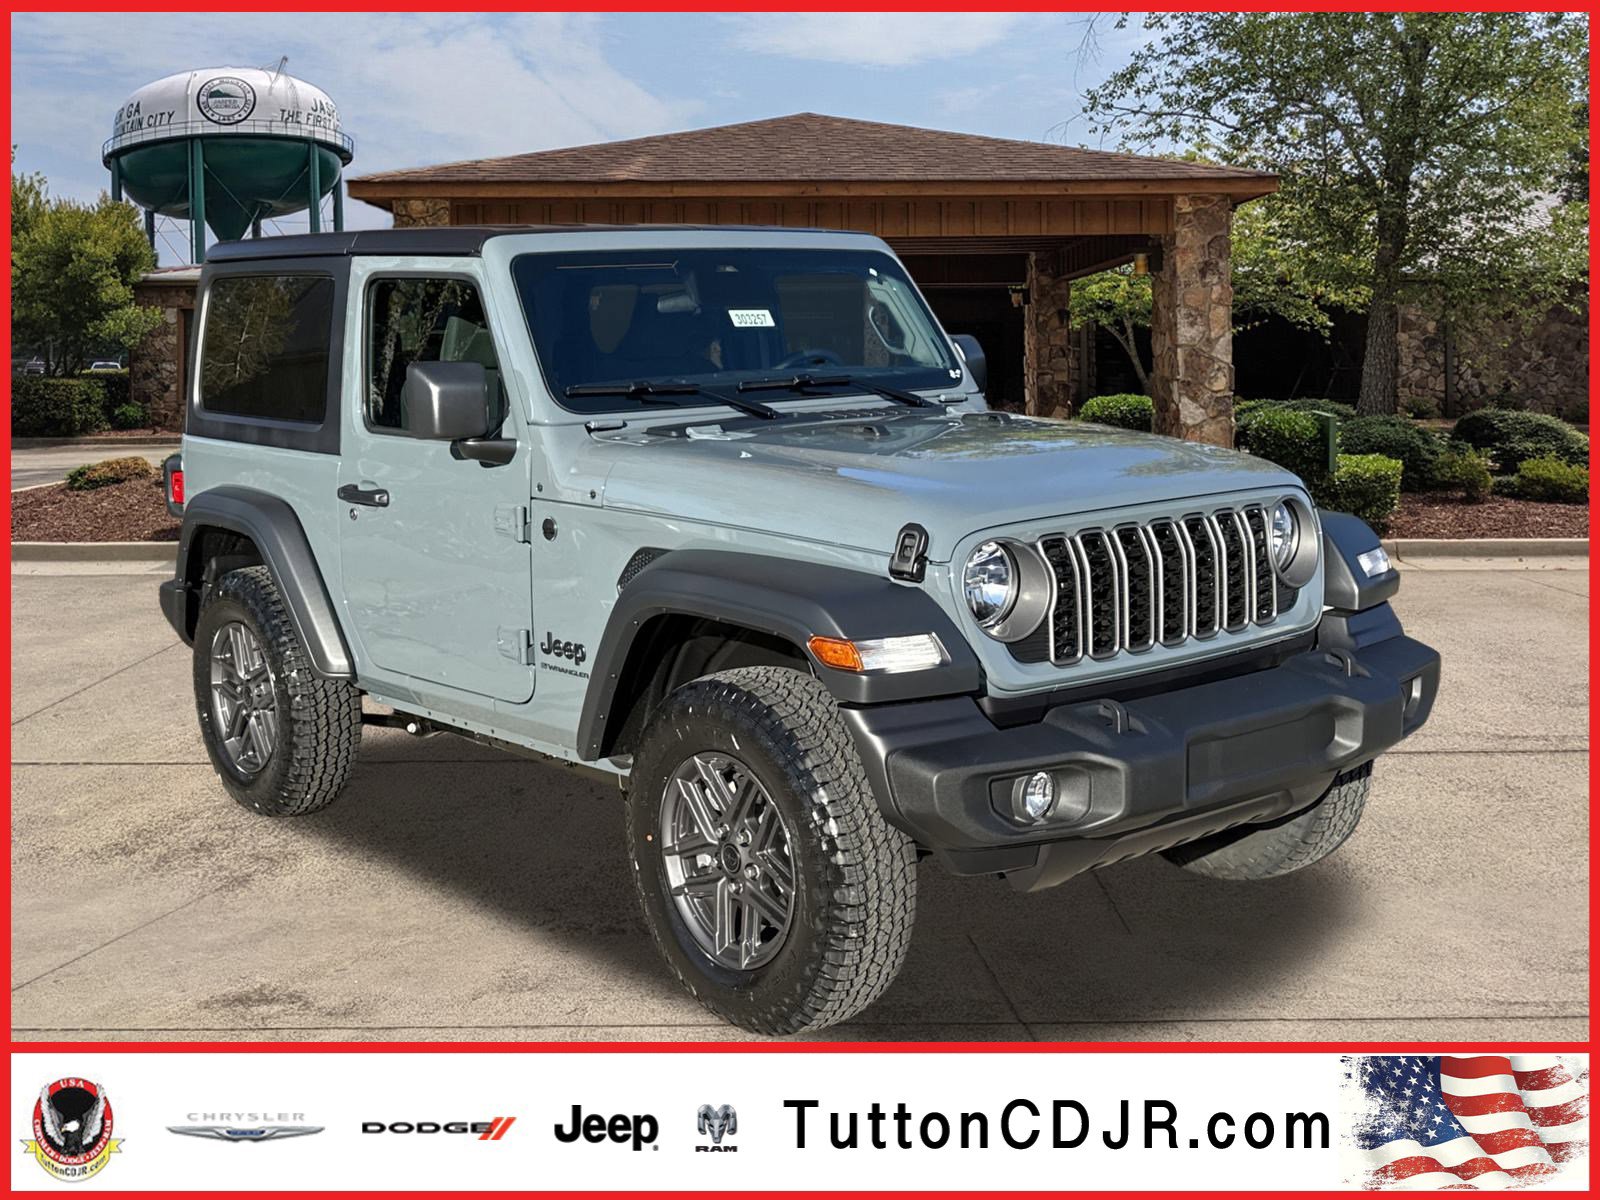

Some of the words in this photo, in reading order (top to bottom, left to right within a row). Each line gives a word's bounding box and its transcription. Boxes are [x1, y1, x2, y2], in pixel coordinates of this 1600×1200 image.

[127, 101, 140, 118] GA
[147, 110, 175, 127] CITY
[280, 108, 302, 124] THE
[306, 112, 332, 129] FIRST
[735, 313, 767, 325] 303257
[540, 631, 587, 666] Jeep
[548, 663, 590, 679] WRANGLER
